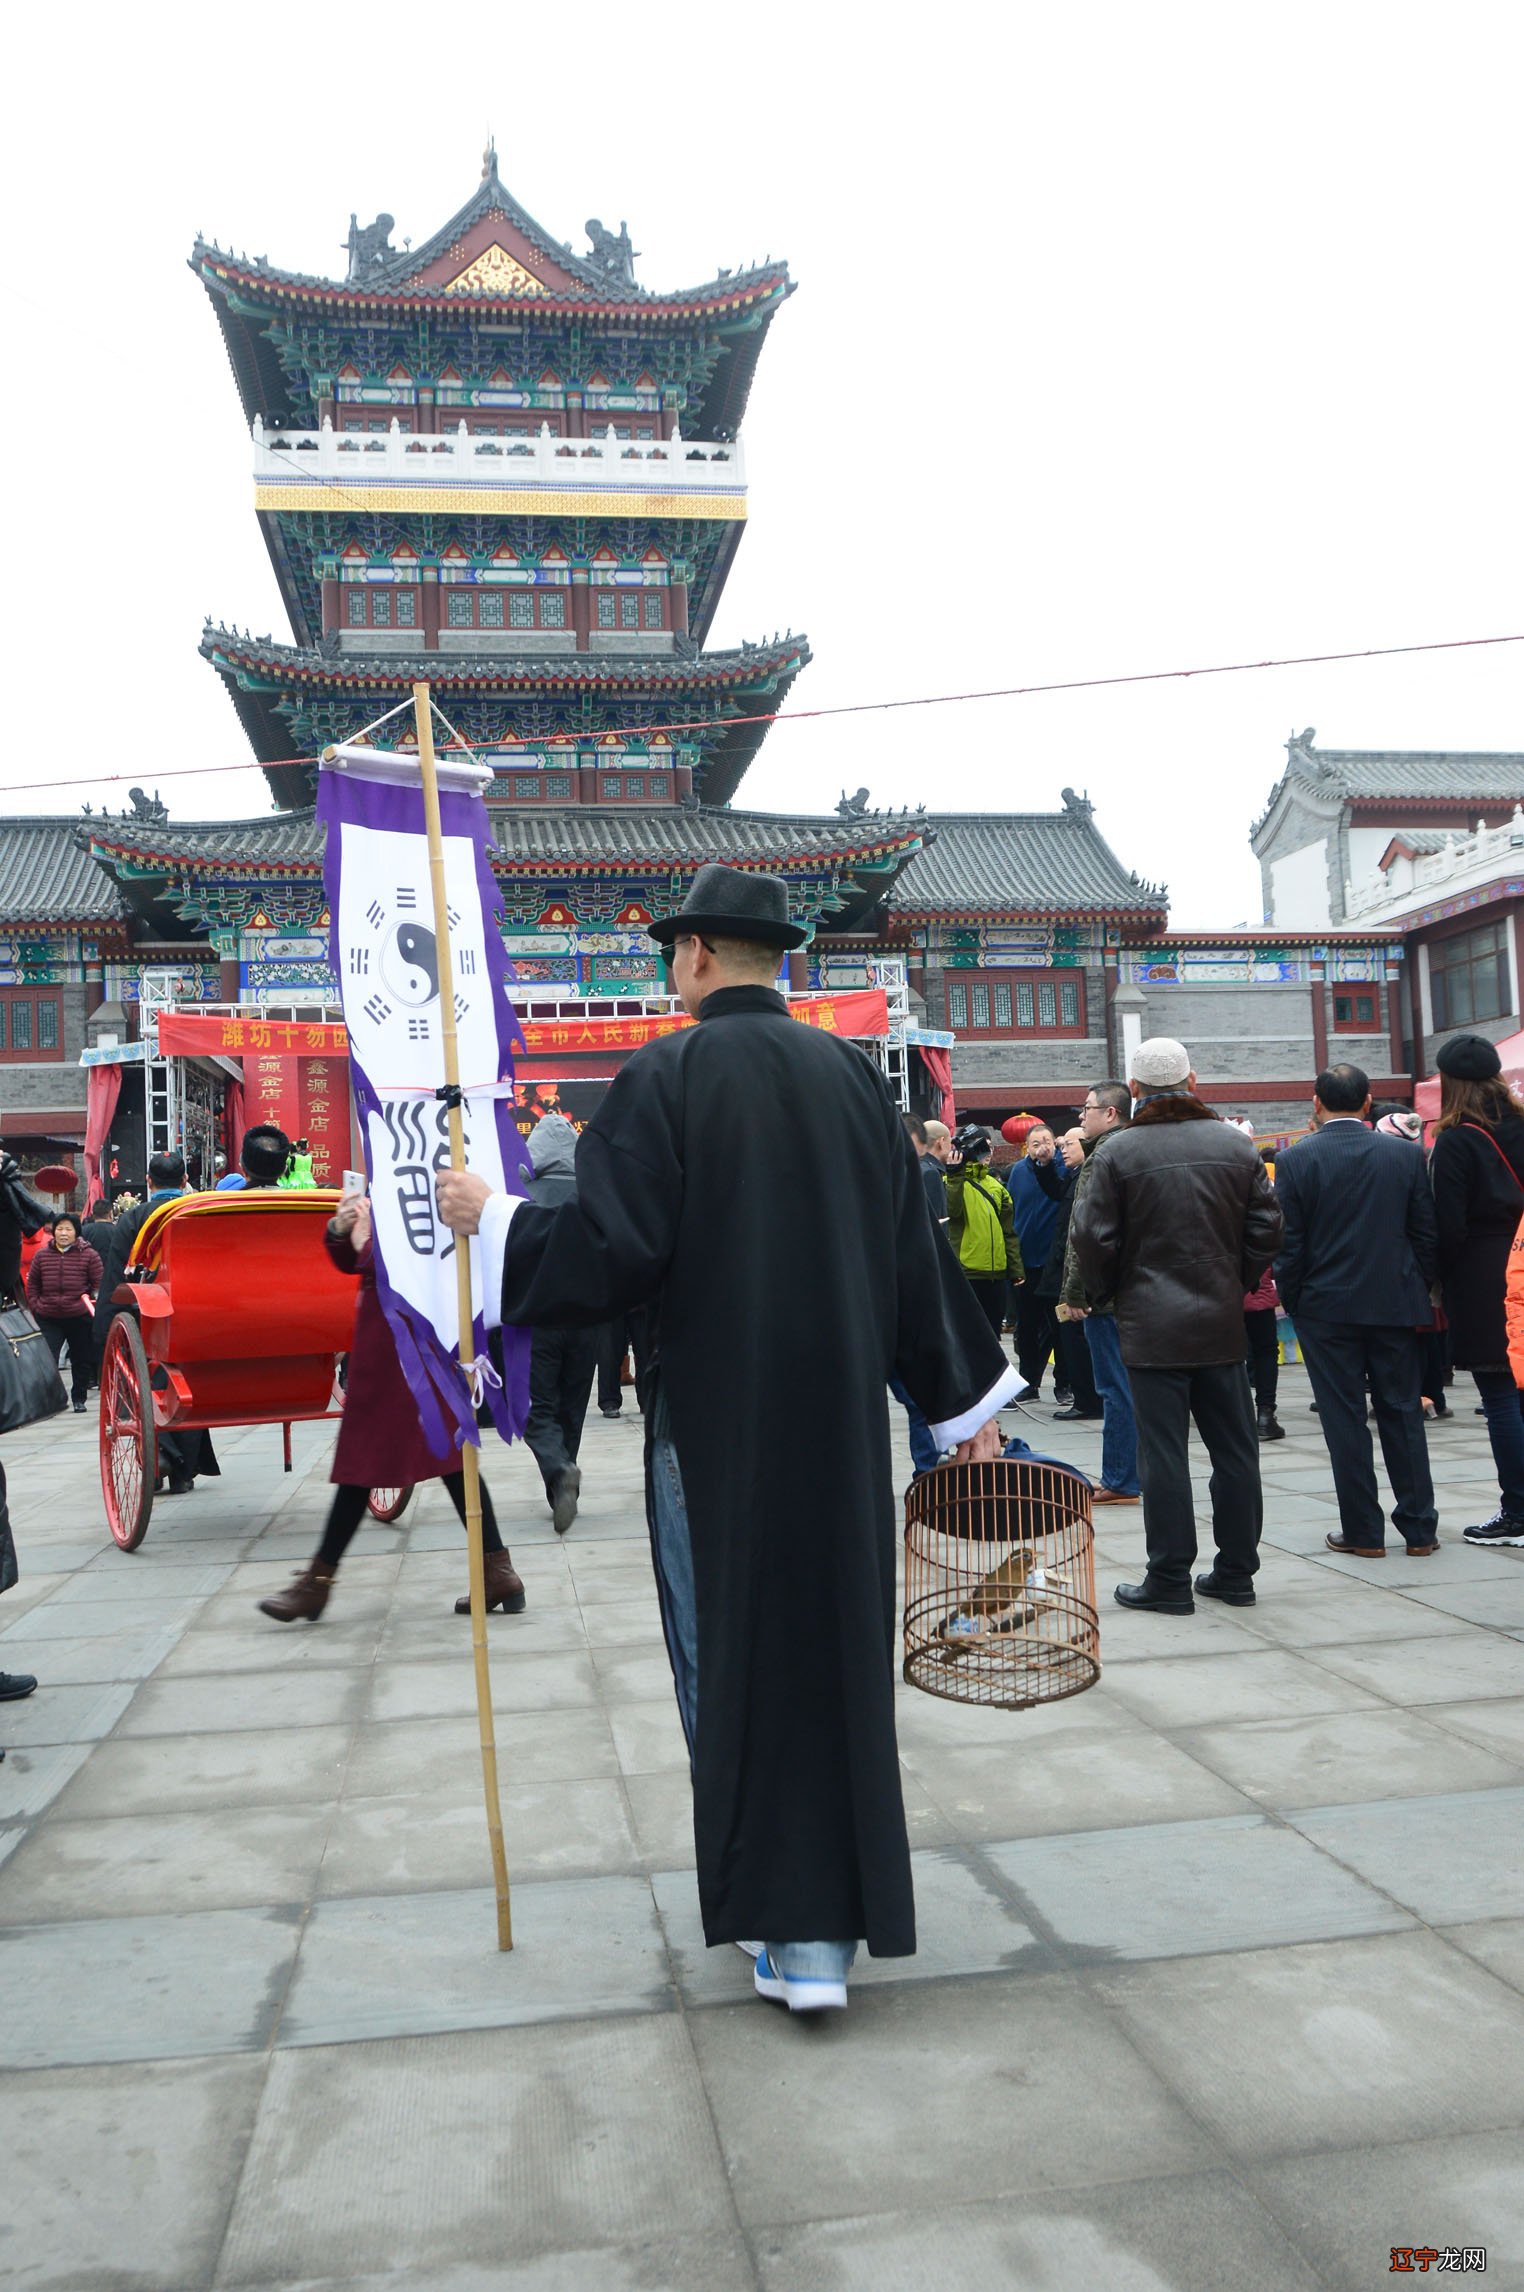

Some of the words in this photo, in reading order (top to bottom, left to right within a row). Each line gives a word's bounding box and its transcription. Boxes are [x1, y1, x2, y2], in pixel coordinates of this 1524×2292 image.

[258, 1056, 283, 1099] 源金店
[307, 1059, 330, 1132] 鑫源金店
[310, 1144, 331, 1178] 品质
